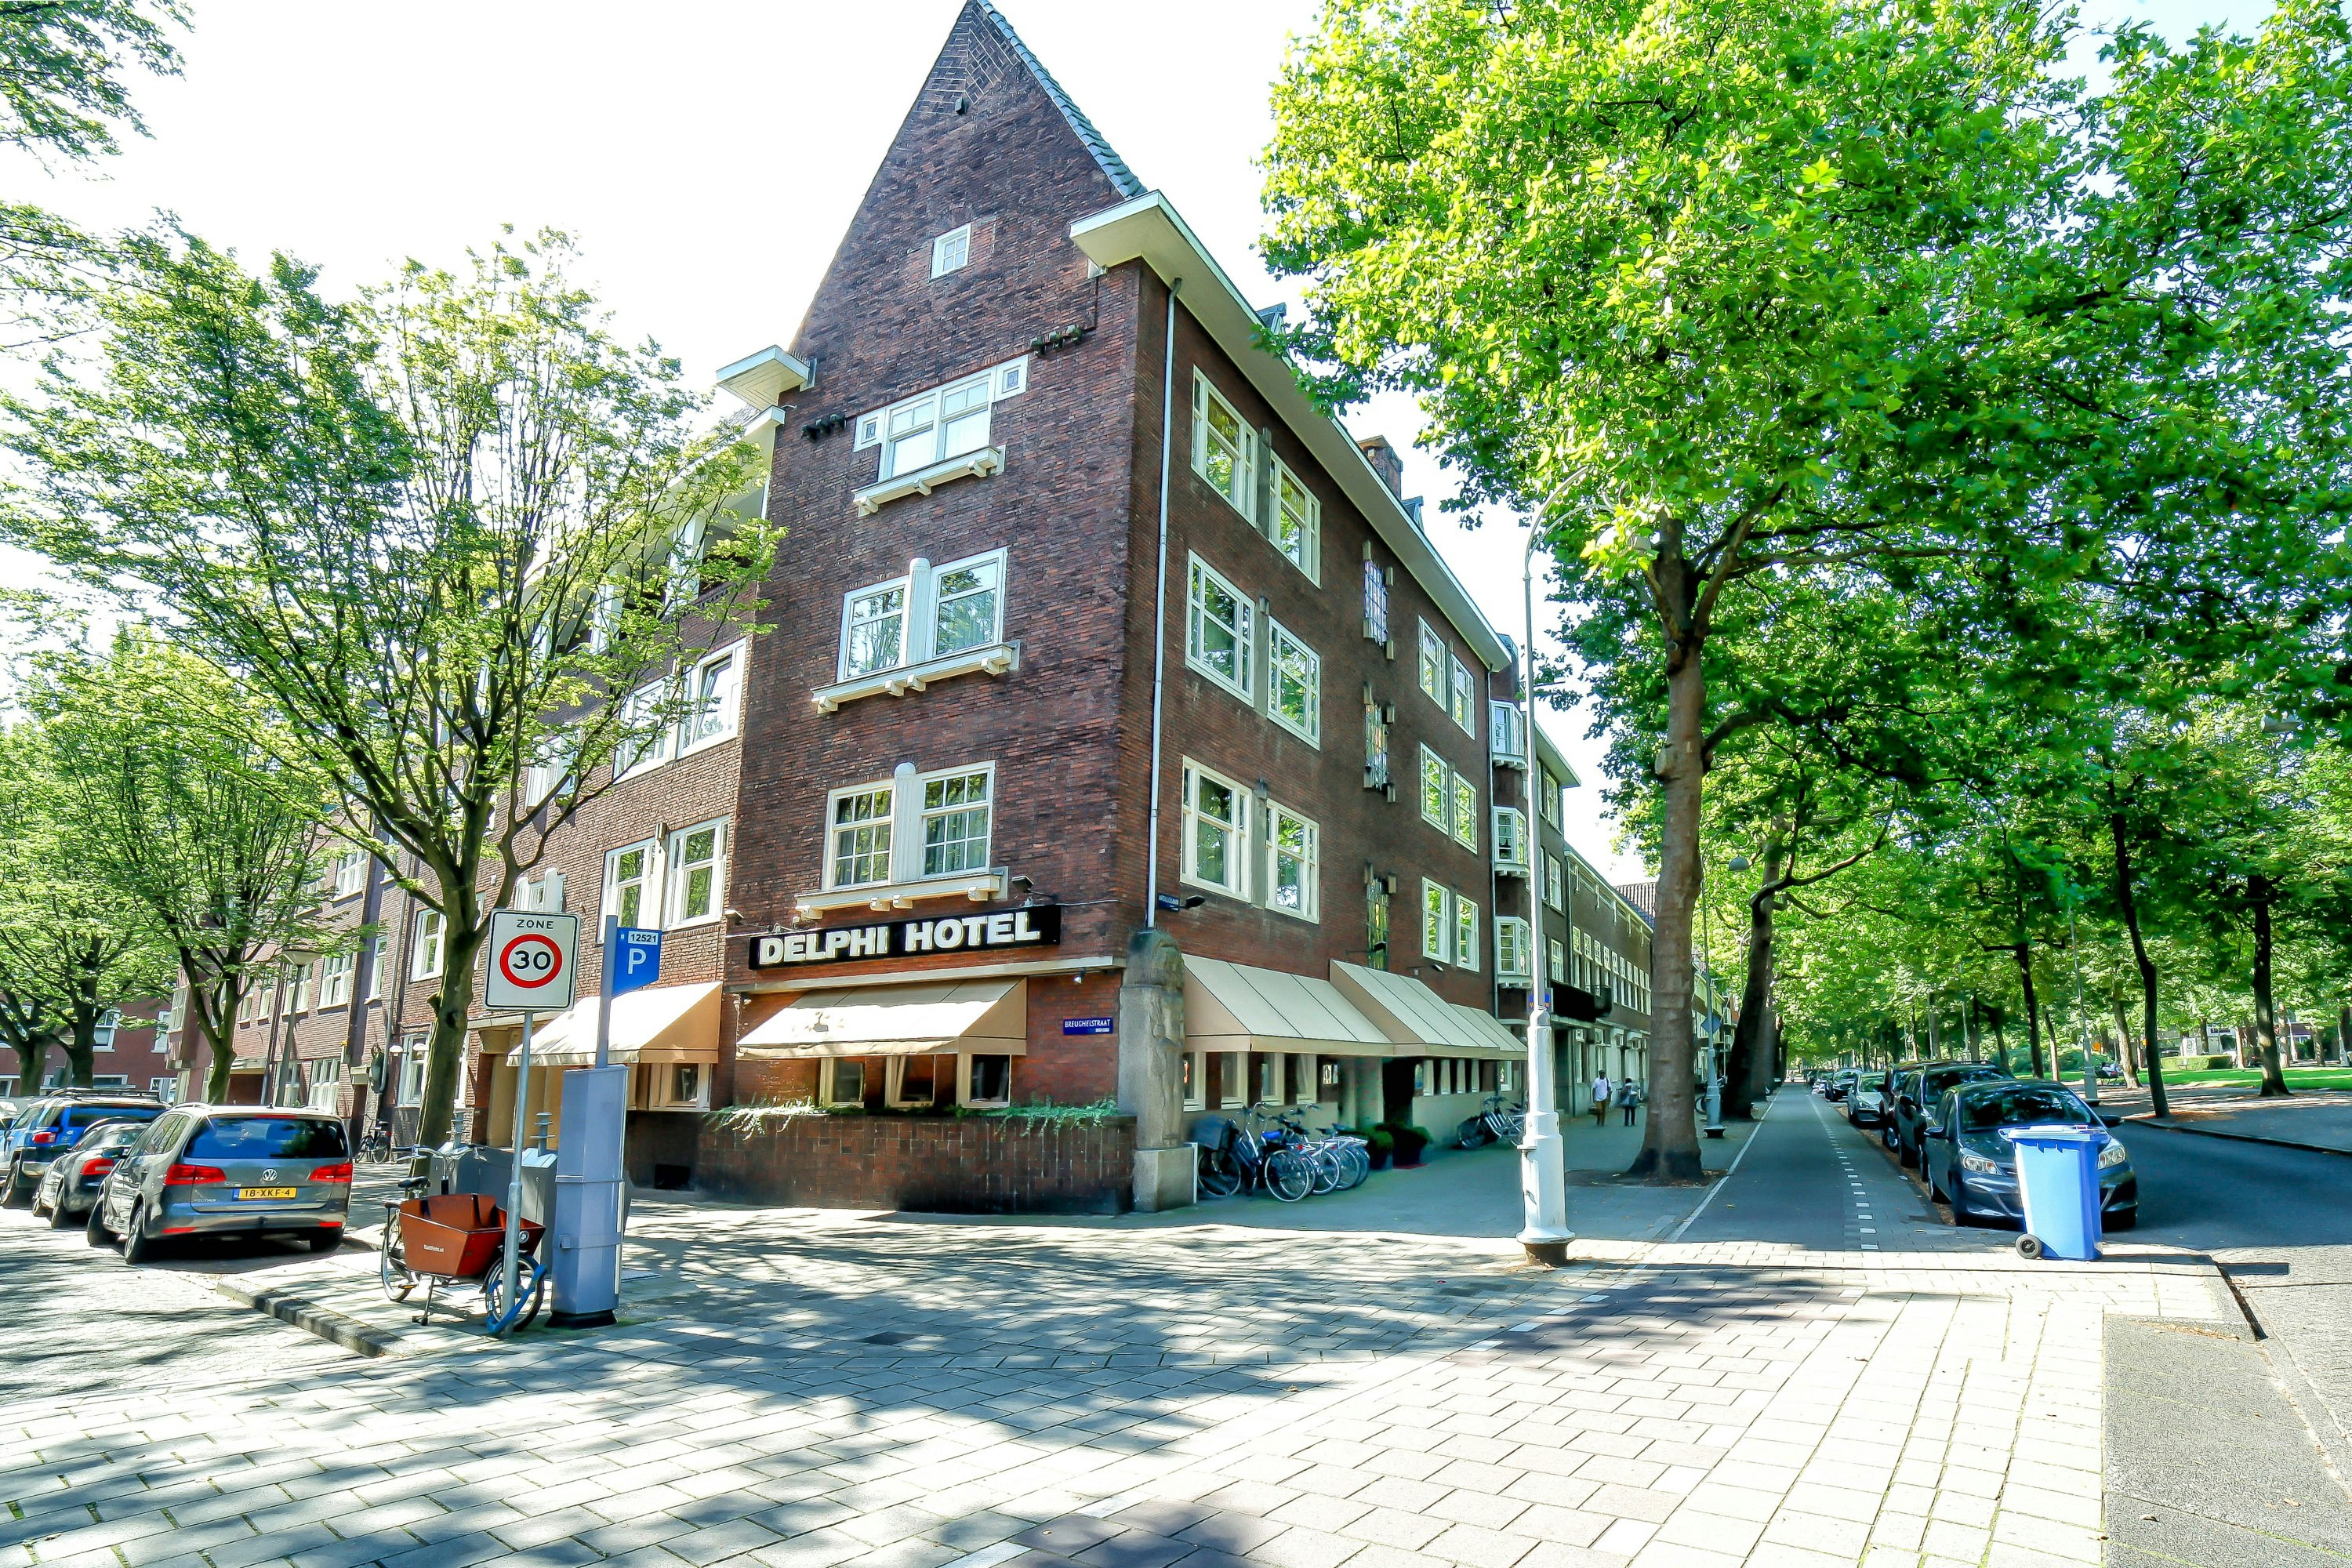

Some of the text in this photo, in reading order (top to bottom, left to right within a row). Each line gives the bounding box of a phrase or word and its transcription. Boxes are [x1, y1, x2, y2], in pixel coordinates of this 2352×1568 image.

[516, 919, 554, 930] ZONE
[630, 933, 657, 943] 12521
[760, 911, 1041, 964] DELPHI HOTEL
[512, 950, 551, 971] 30
[627, 948, 647, 975] P
[1065, 1019, 1110, 1028] BREUGHELSTRAAT
